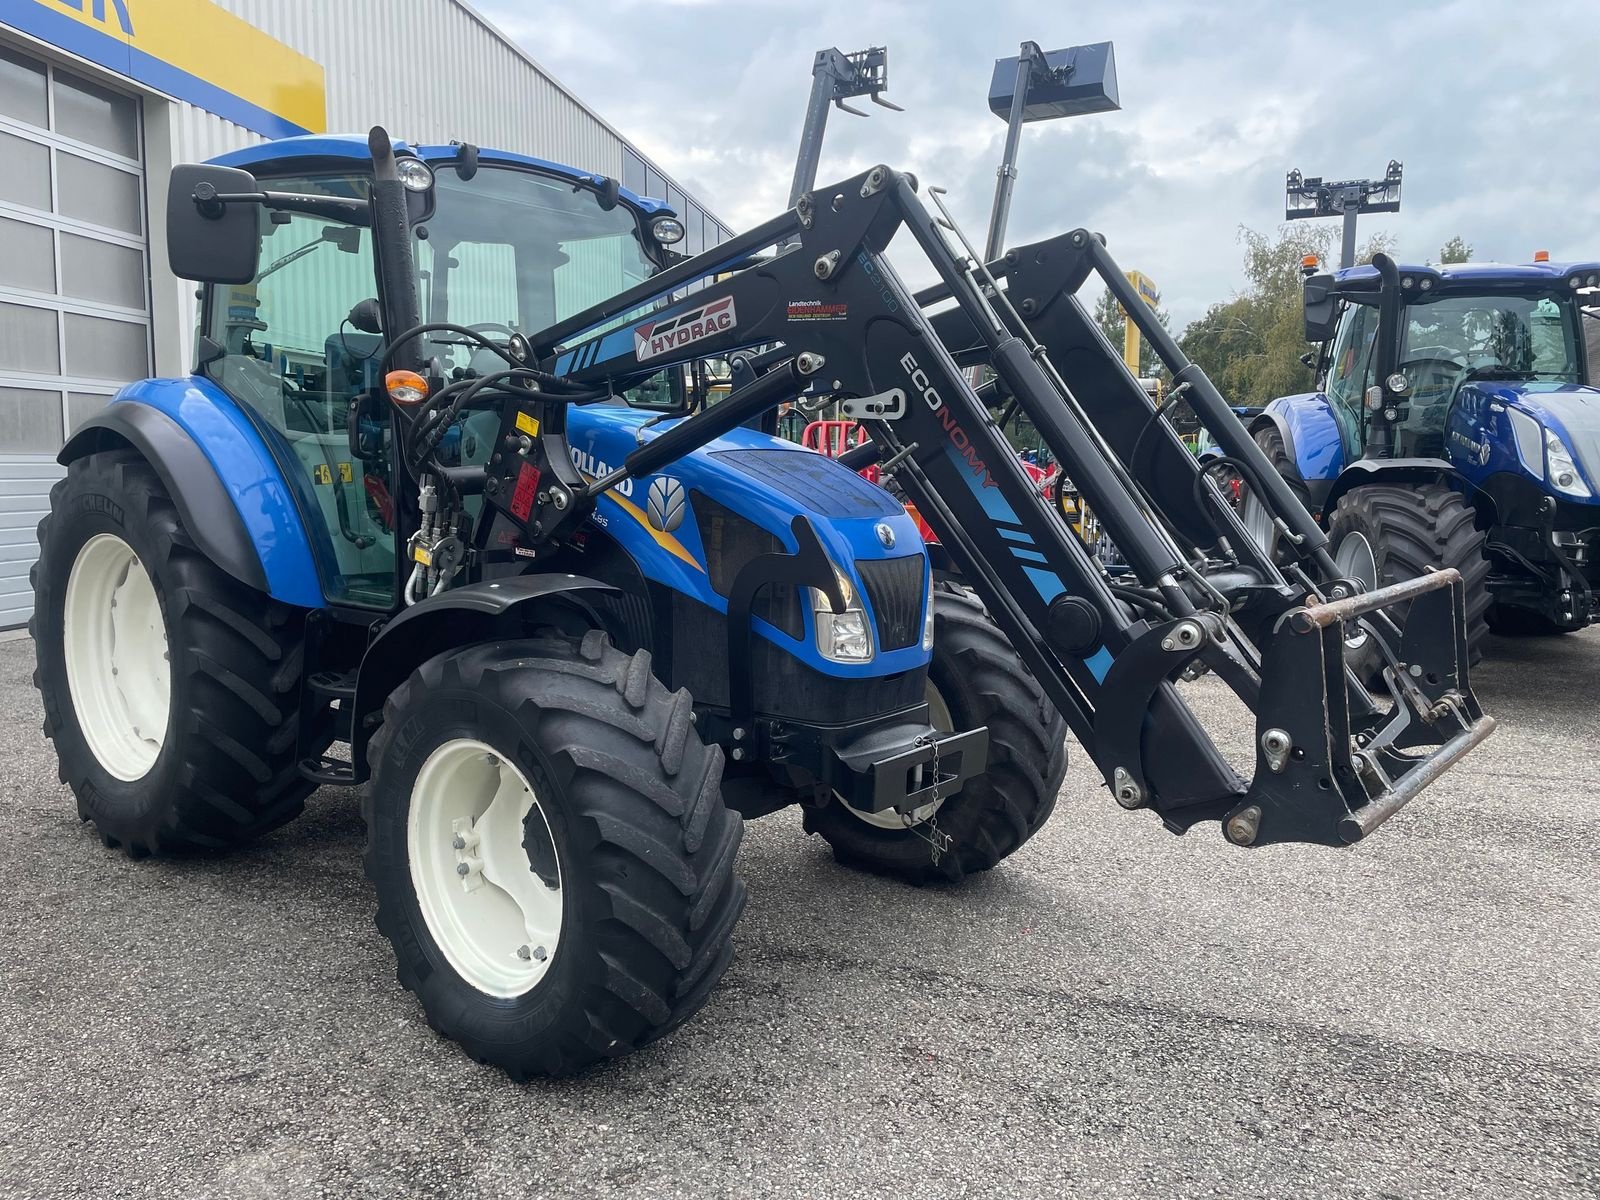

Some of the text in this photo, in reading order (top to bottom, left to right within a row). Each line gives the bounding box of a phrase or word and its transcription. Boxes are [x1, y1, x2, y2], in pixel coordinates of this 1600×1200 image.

[651, 312, 731, 354] HYDRAC
[900, 351, 1000, 488] ECONOMY
[568, 445, 634, 497] OLLAD
